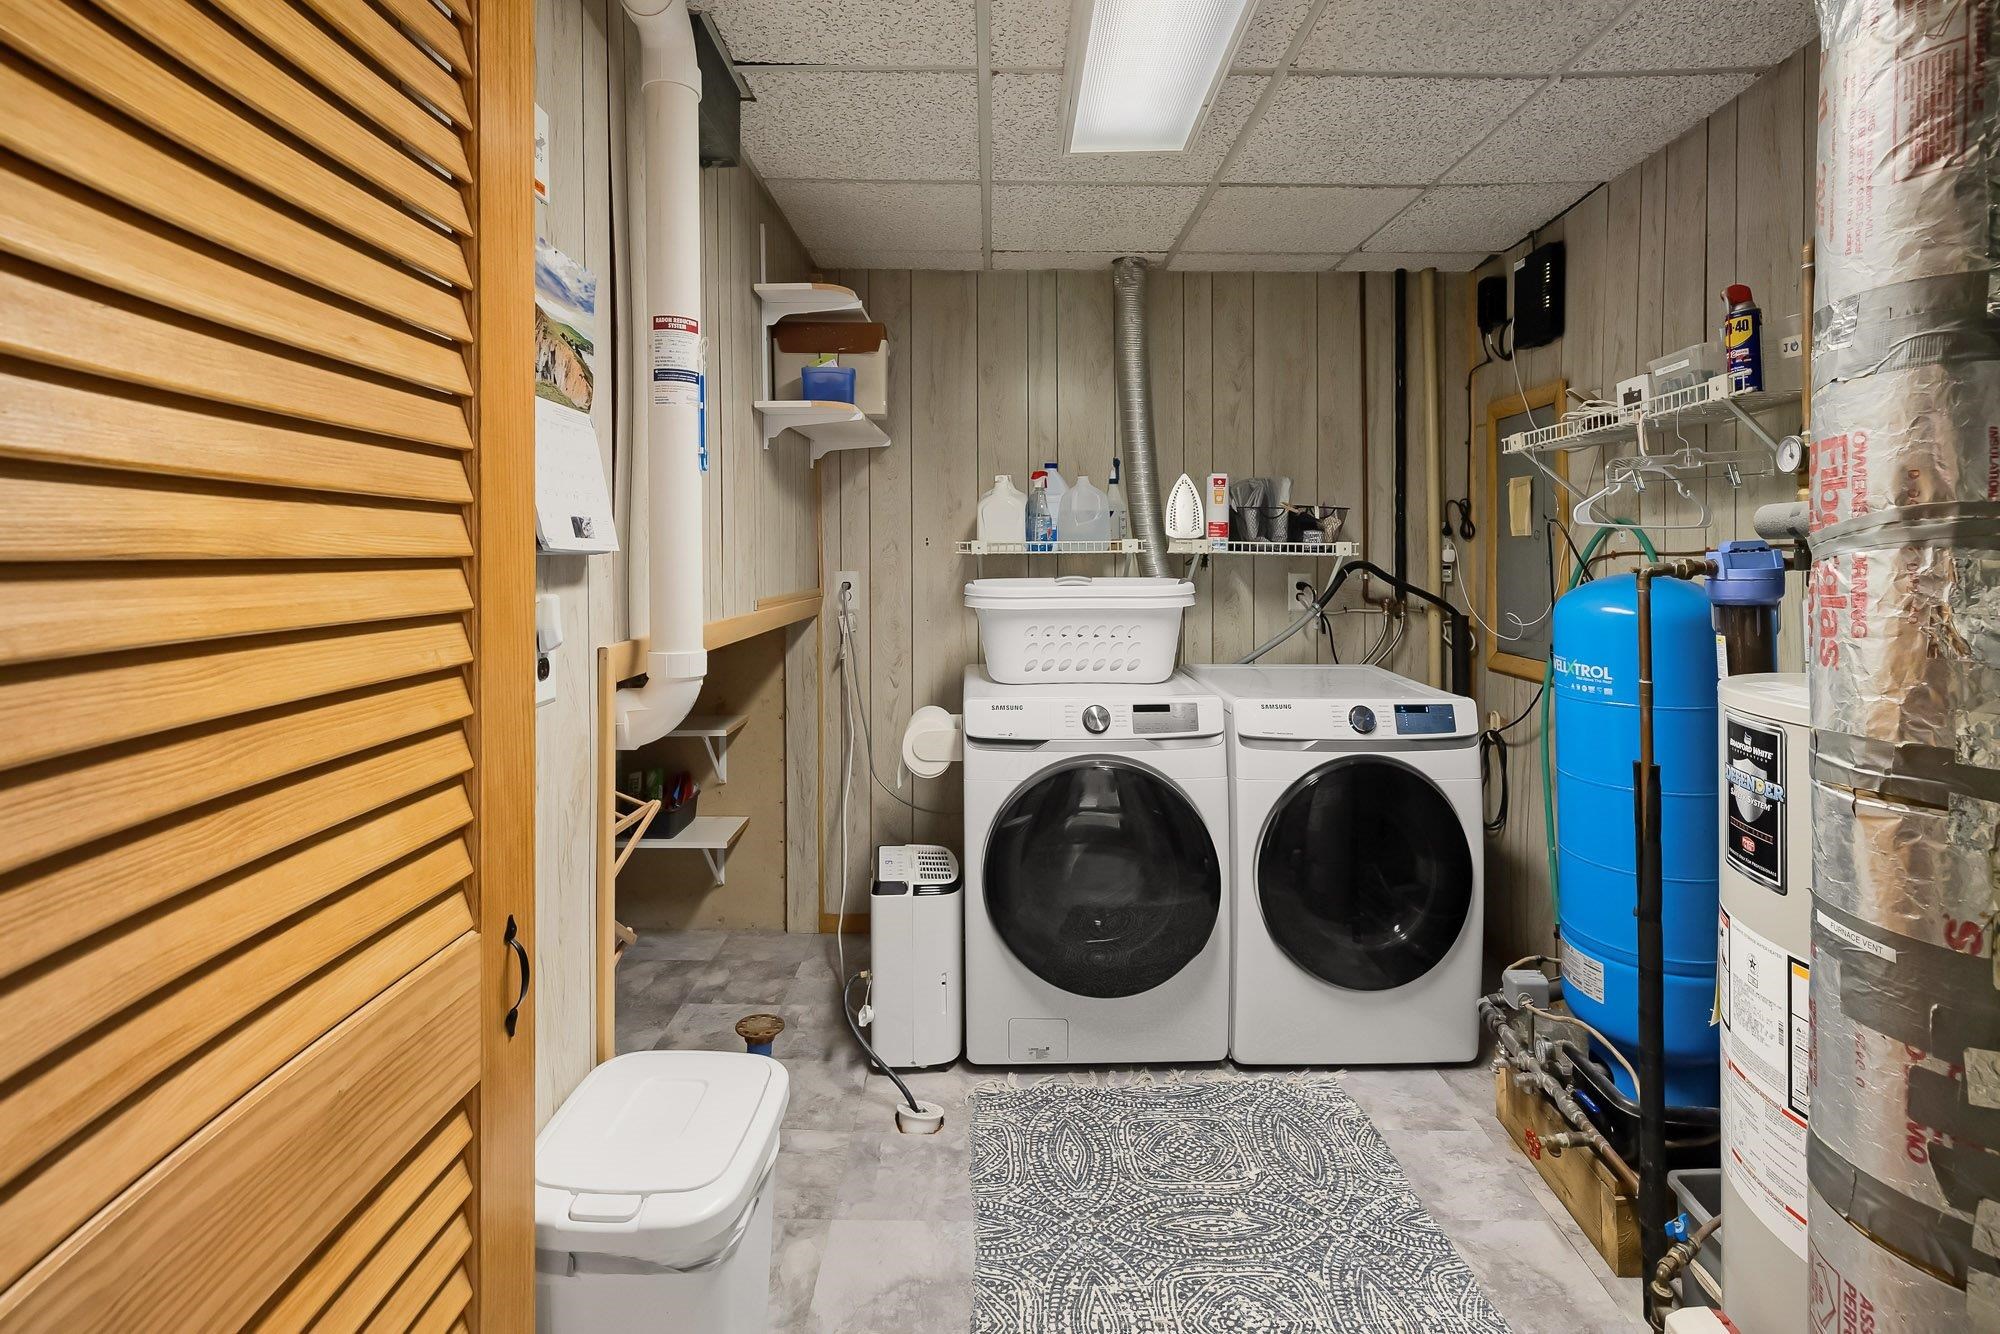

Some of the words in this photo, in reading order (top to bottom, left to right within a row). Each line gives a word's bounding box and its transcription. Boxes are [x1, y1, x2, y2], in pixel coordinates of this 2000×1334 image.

[1729, 738, 1752, 753] BRADFORD
[1753, 746, 1773, 760] WHITE
[1725, 763, 1786, 803] DEFENDER
[1747, 796, 1771, 812] SYSTEM
[1830, 920, 1861, 946] FURNACE
[1861, 936, 1883, 955] VENT
